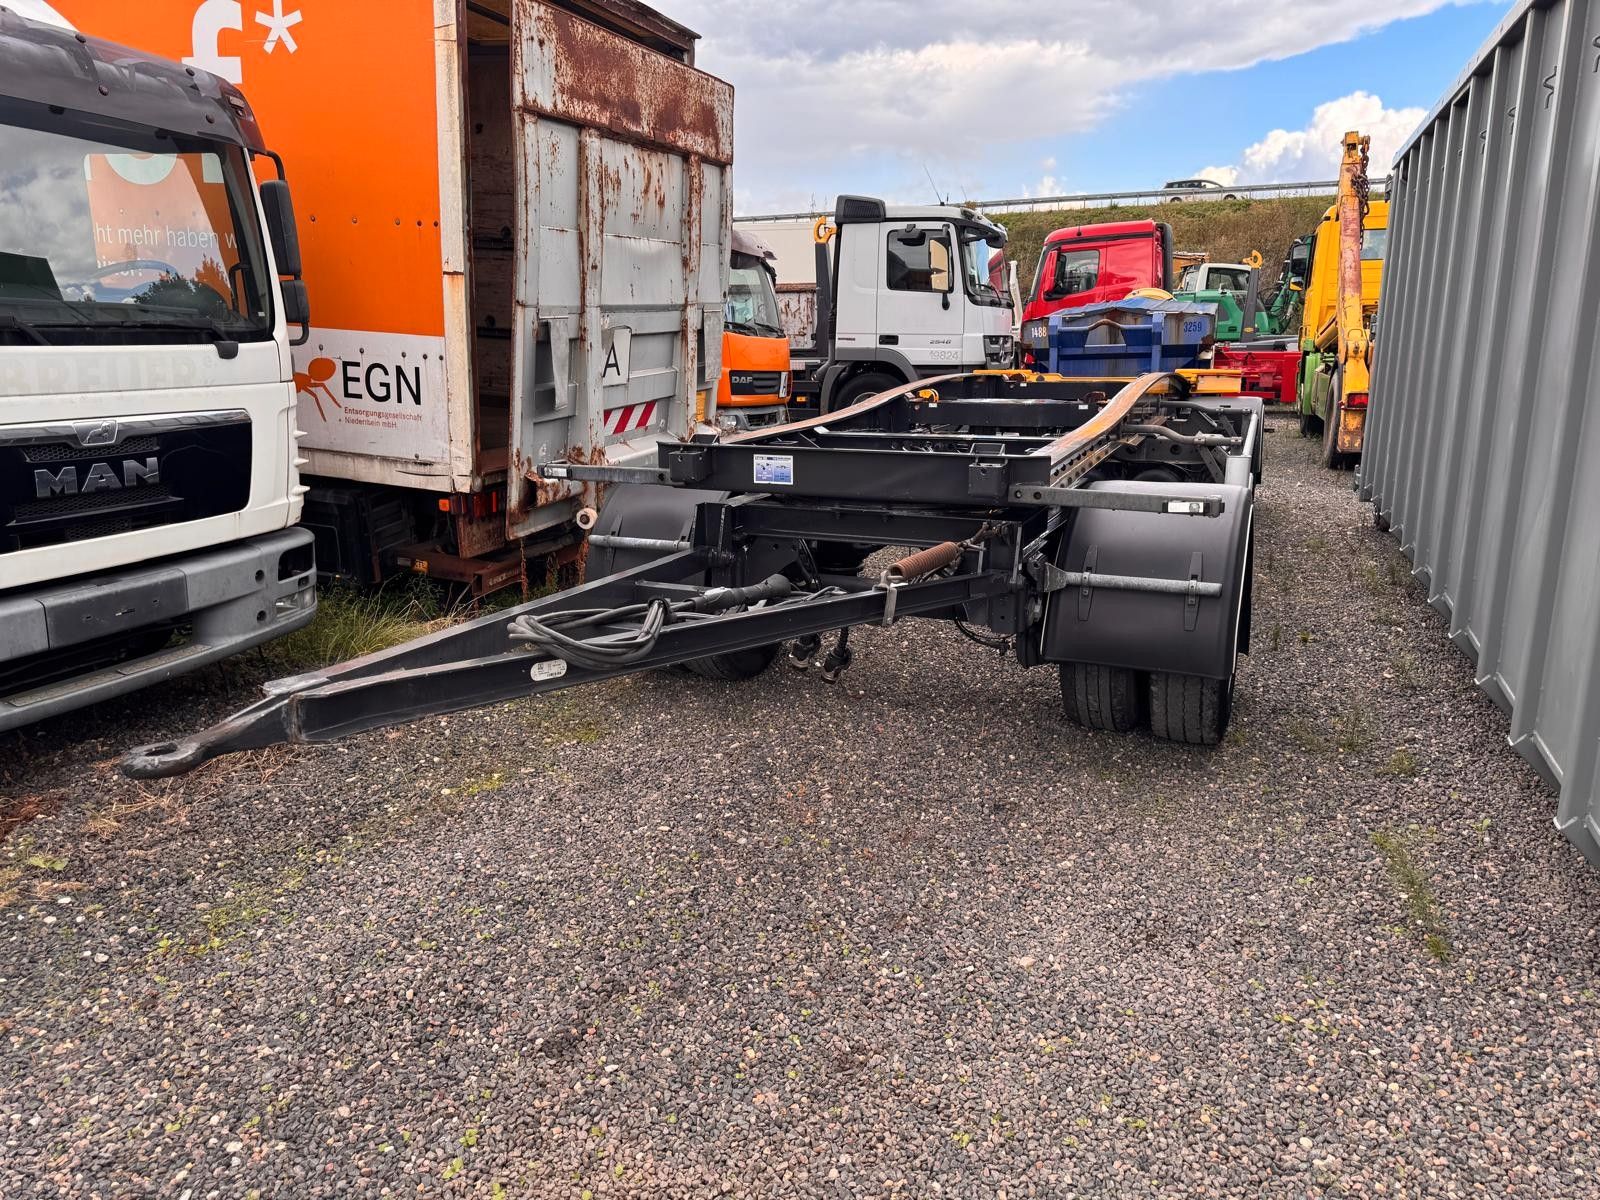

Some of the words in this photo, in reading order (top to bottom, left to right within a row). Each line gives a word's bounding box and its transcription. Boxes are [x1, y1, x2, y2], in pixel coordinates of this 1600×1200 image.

[118, 224, 160, 245] mehr
[166, 225, 219, 249] haben
[1031, 326, 1047, 338] 1488
[1183, 321, 1202, 333] 3259
[602, 342, 621, 378] A
[342, 361, 421, 405] EGN
[732, 376, 753, 385] DAF
[344, 407, 422, 421] Entsorgungsgesellschaft
[34, 457, 160, 499] MAN
